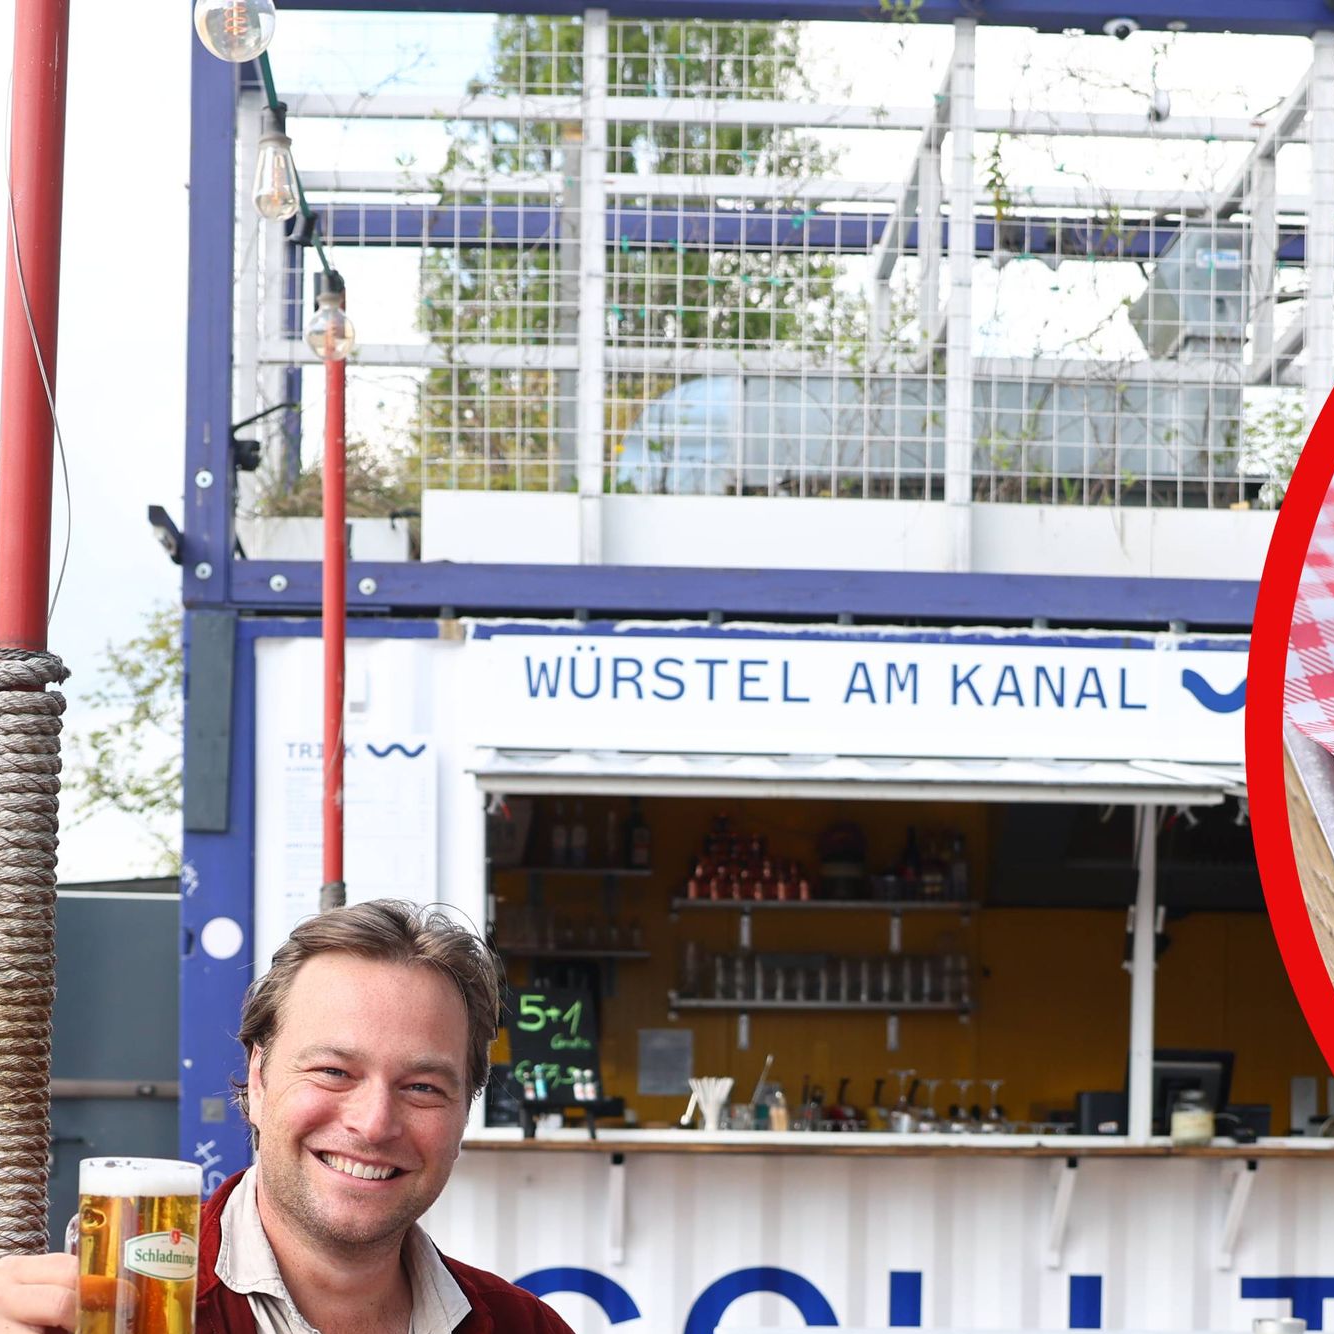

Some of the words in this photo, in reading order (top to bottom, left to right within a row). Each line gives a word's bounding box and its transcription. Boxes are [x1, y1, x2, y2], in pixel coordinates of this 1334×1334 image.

[525, 655, 812, 703] WÜRSTEL
[843, 661, 920, 705] AM
[951, 664, 1149, 711] KANAL
[135, 1248, 197, 1268] Schladming
